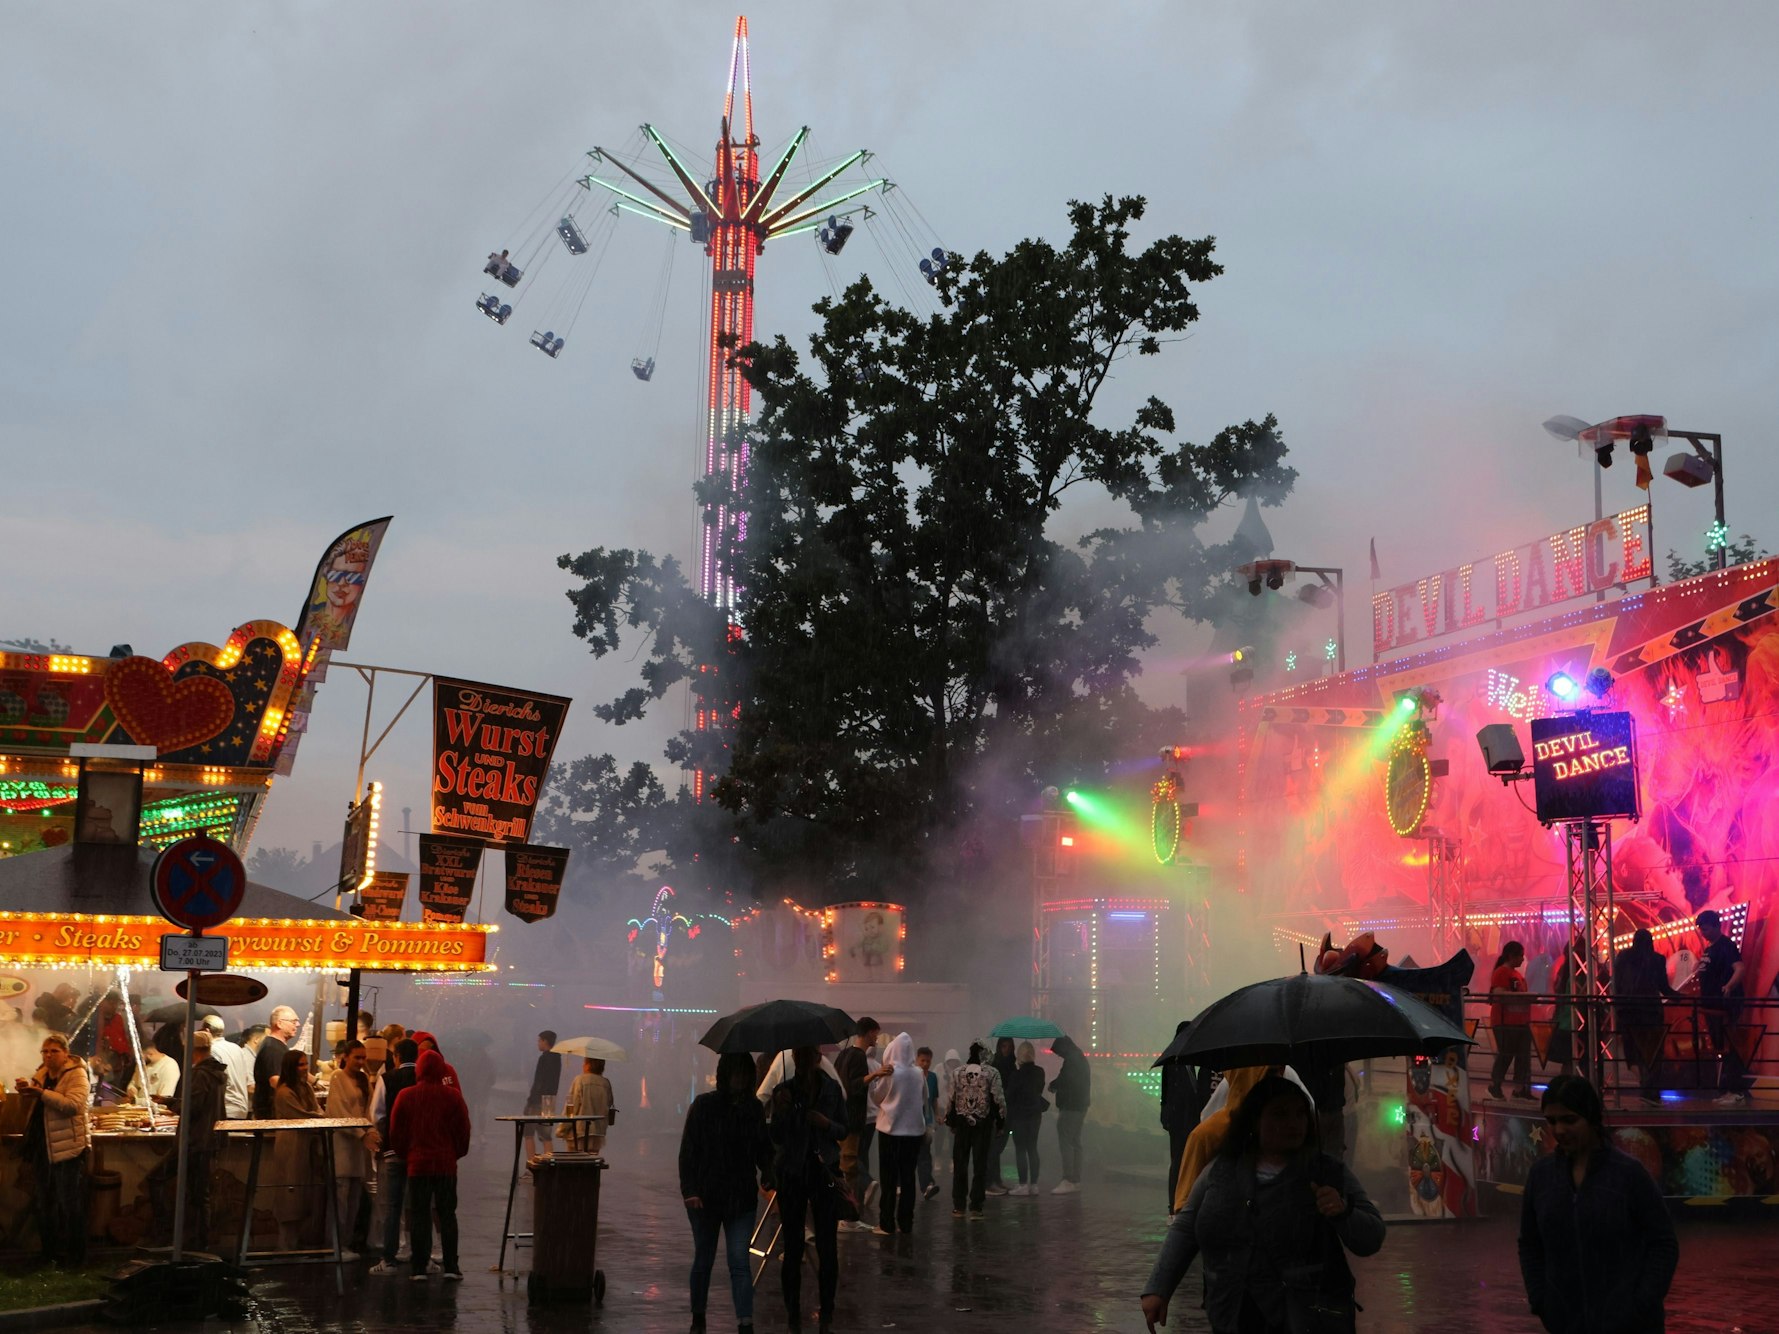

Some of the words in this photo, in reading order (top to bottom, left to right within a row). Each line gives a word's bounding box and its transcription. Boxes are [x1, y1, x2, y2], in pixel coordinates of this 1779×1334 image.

[1372, 563, 1486, 652] DEVIL
[1494, 503, 1651, 618] DANCE
[458, 689, 541, 722] Dierichs
[444, 708, 549, 758] Wurst
[1534, 731, 1599, 760] DEVIL
[474, 753, 505, 767] UND
[1553, 746, 1631, 780] DANCE
[434, 750, 538, 806] Steaks
[434, 806, 527, 840] Schwenkgrill
[463, 801, 489, 816] vom
[434, 854, 463, 867] XXL
[55, 925, 142, 950] Steaks
[331, 931, 353, 953] &
[360, 932, 464, 955] Pommes
[188, 941, 198, 949] ab
[178, 957, 194, 965] 7.00
